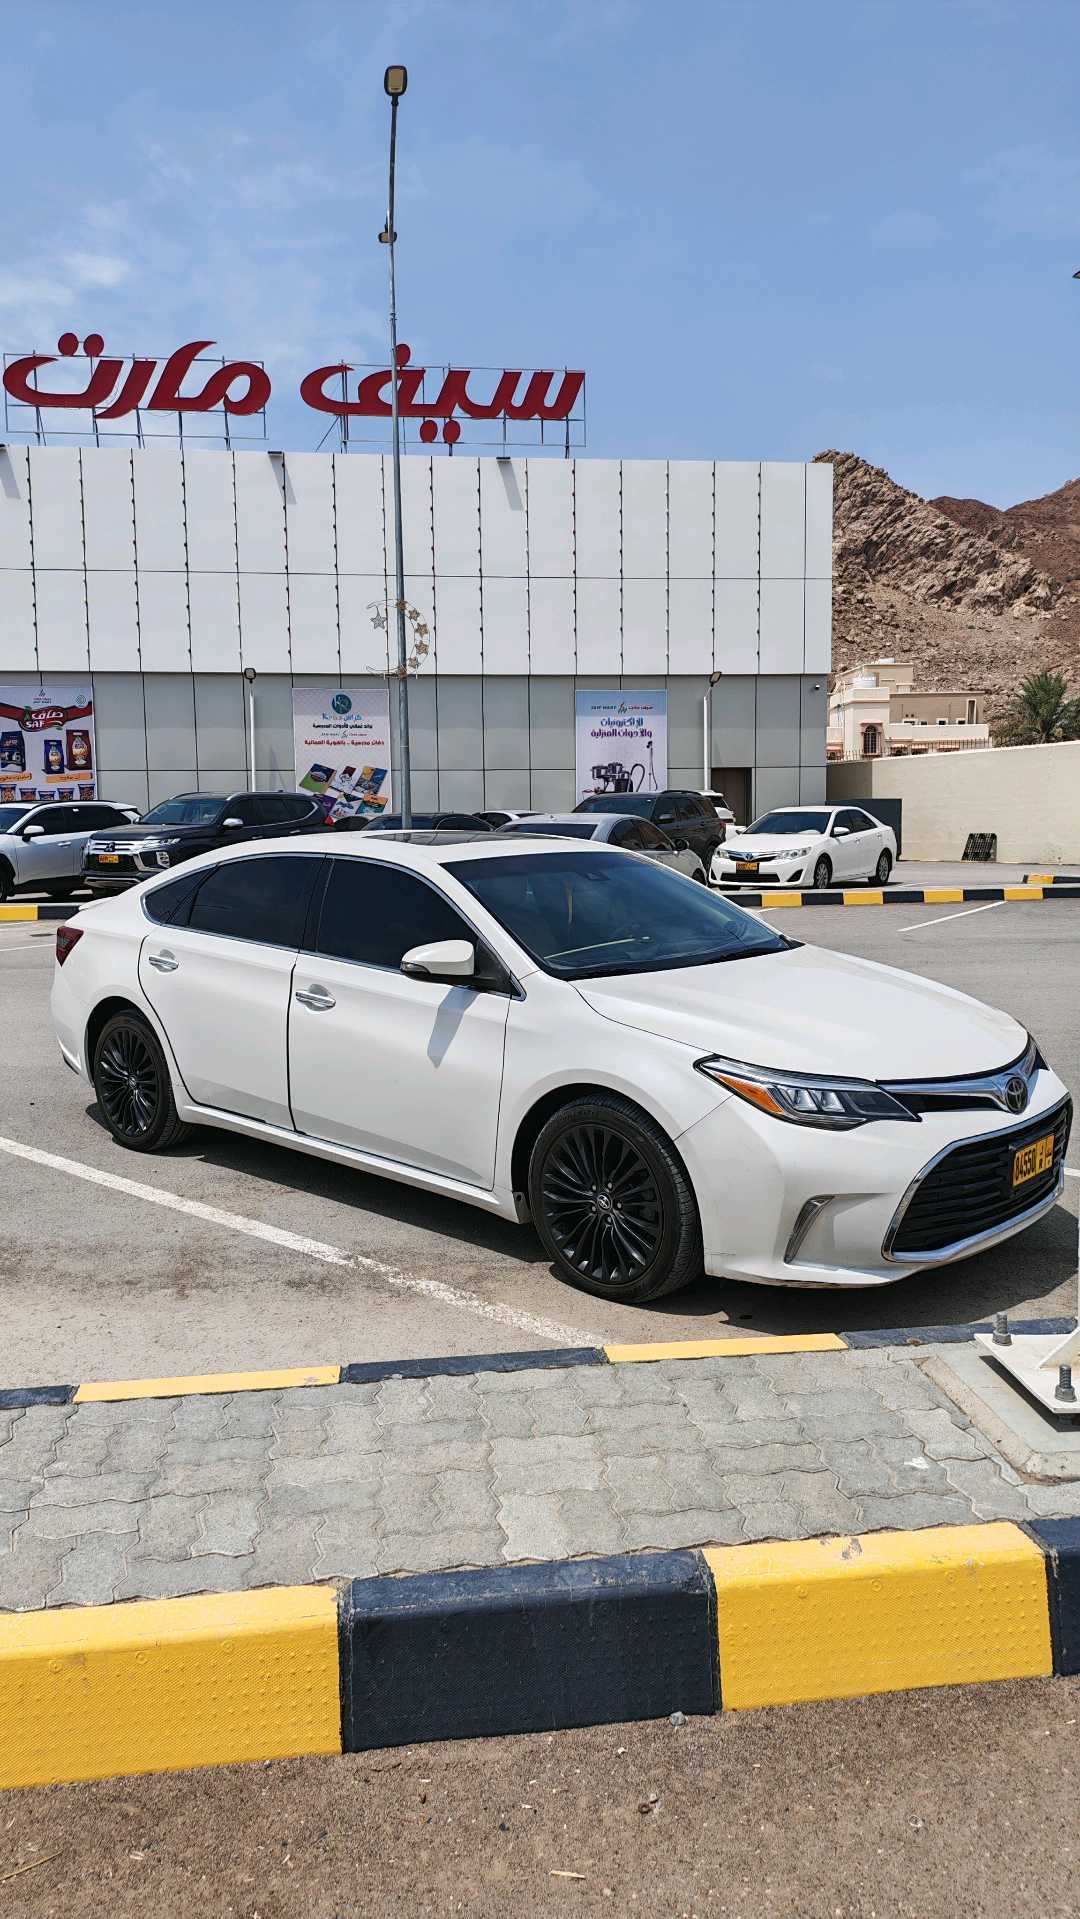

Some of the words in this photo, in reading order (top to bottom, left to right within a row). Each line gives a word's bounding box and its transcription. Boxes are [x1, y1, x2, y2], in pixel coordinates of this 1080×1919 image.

[2, 332, 272, 419] مارت
[300, 344, 586, 443] سيف
[25, 720, 45, 729] SAF
